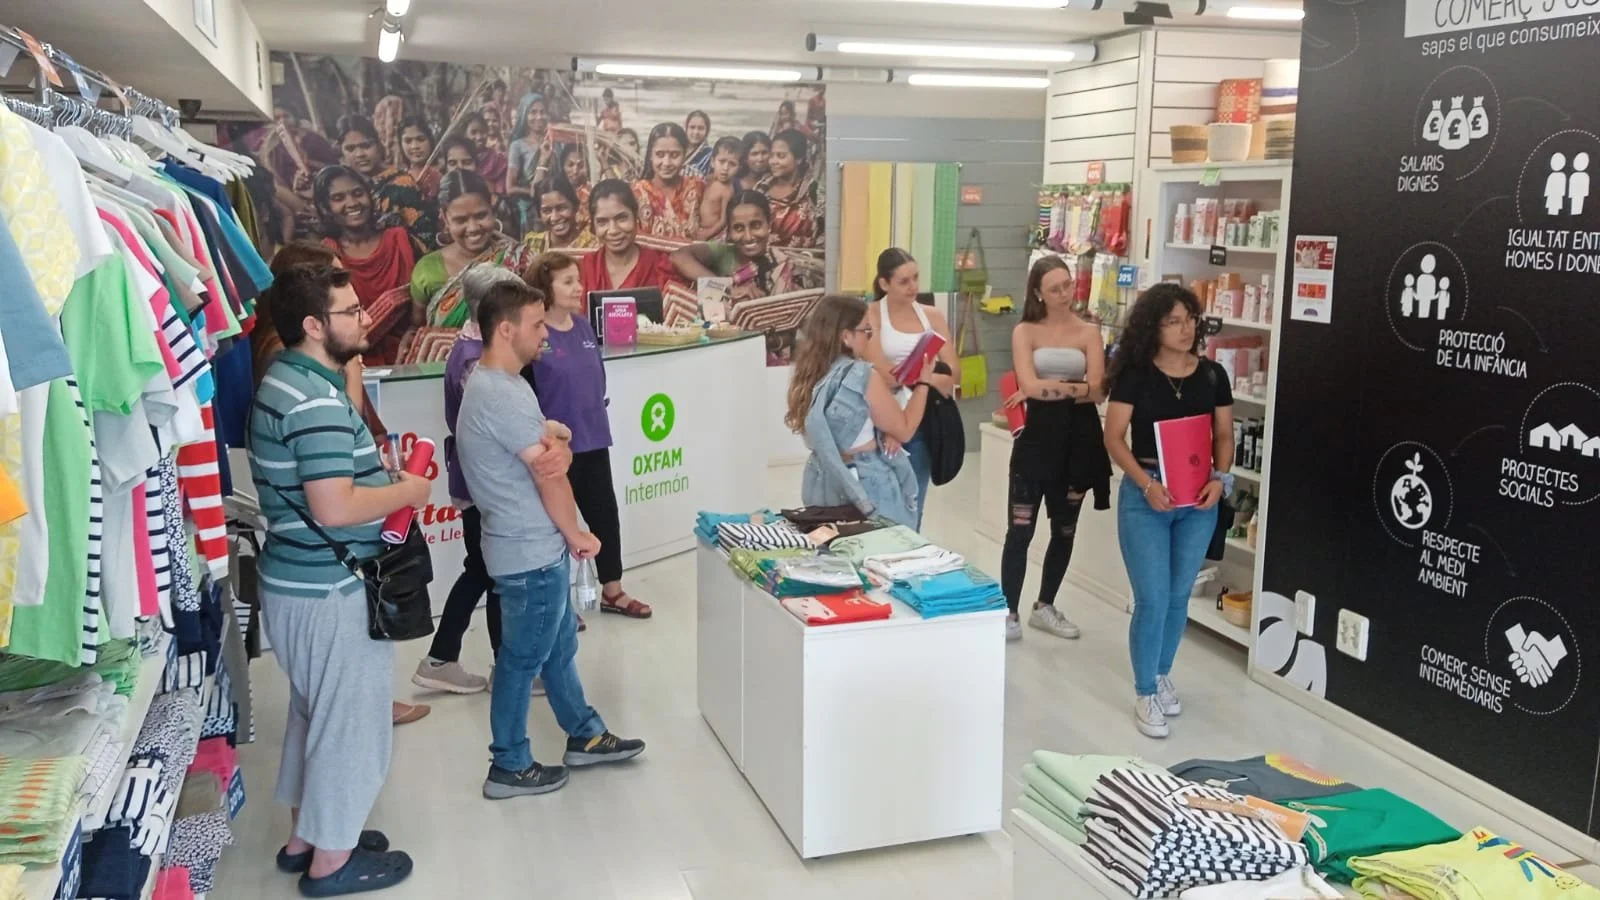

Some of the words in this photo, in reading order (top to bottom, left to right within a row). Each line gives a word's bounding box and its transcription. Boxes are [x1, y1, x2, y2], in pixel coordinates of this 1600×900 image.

[1422, 38, 1455, 58] saps
[1459, 32, 1472, 50] el
[1477, 31, 1505, 53] que
[1400, 154, 1445, 172] SALARIS
[1397, 174, 1439, 192] DIGNES
[1507, 228, 1570, 248] IGUALTAT
[1505, 250, 1554, 270] HOMES
[1558, 252, 1563, 271] I
[1439, 329, 1505, 354] PROTECCIÓ
[1436, 349, 1453, 368] DE
[1456, 351, 1471, 370] LA
[1474, 353, 1527, 379] INFÀNCIA
[632, 447, 682, 476] OXFAM
[1501, 457, 1579, 492] PROJECTES
[625, 472, 690, 505] Intermón
[1499, 478, 1554, 507] SOCIALS
[1422, 529, 1481, 564] RESPECTE
[1420, 549, 1433, 567] AL
[1437, 554, 1466, 579] MEDI
[1418, 567, 1468, 598] AMBIENT
[1421, 644, 1468, 681] COMERÇ
[1470, 665, 1512, 698] SENSE
[1420, 663, 1503, 713] INTERMEDIARIS
